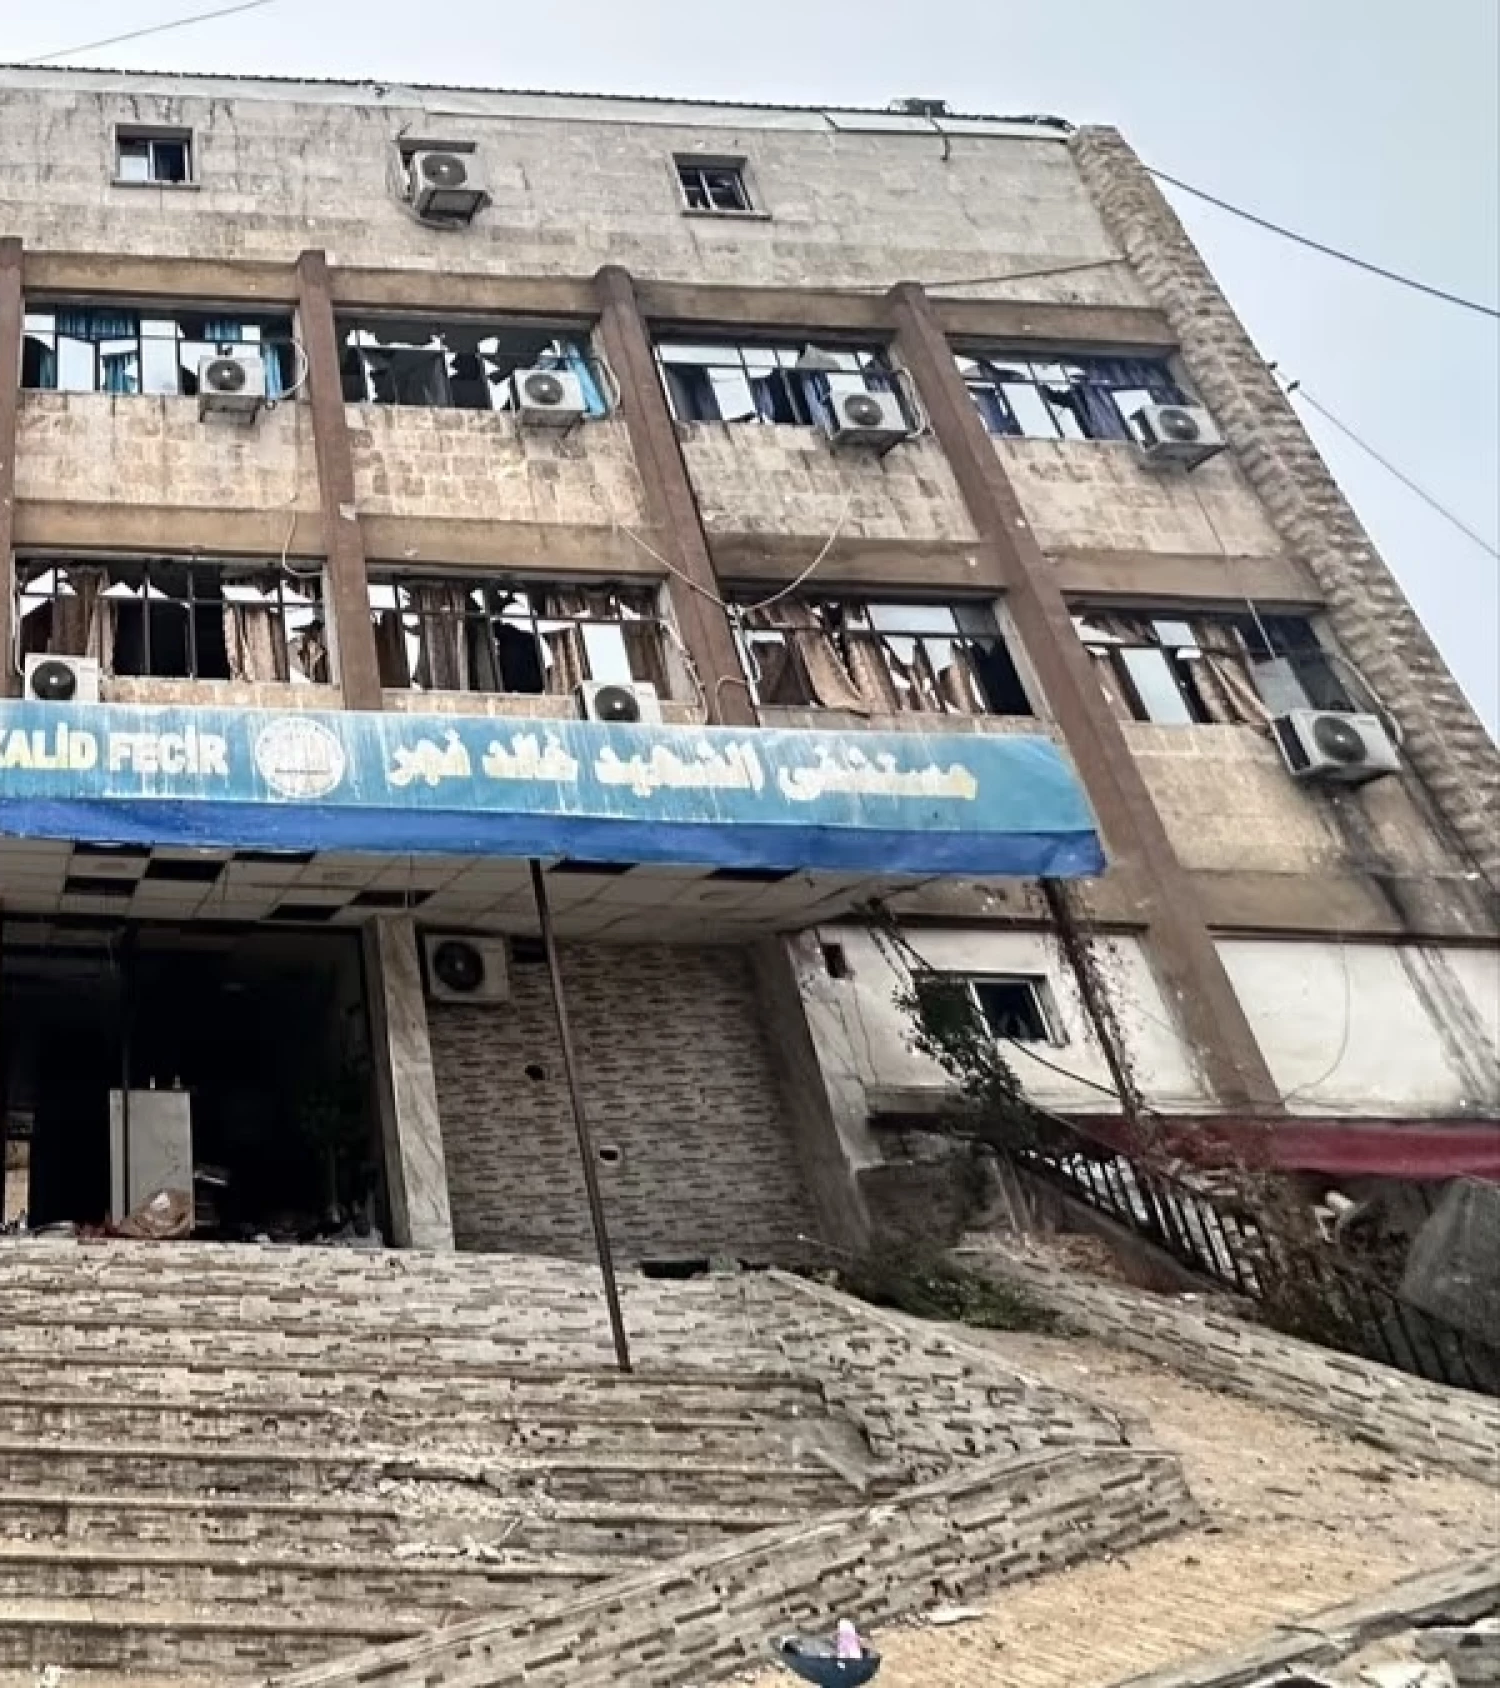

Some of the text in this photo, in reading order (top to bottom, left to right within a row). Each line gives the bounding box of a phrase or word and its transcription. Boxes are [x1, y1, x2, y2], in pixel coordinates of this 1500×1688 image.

[482, 728, 579, 782] خالد
[594, 740, 763, 798] الشهيد
[779, 743, 977, 801] مستشفى
